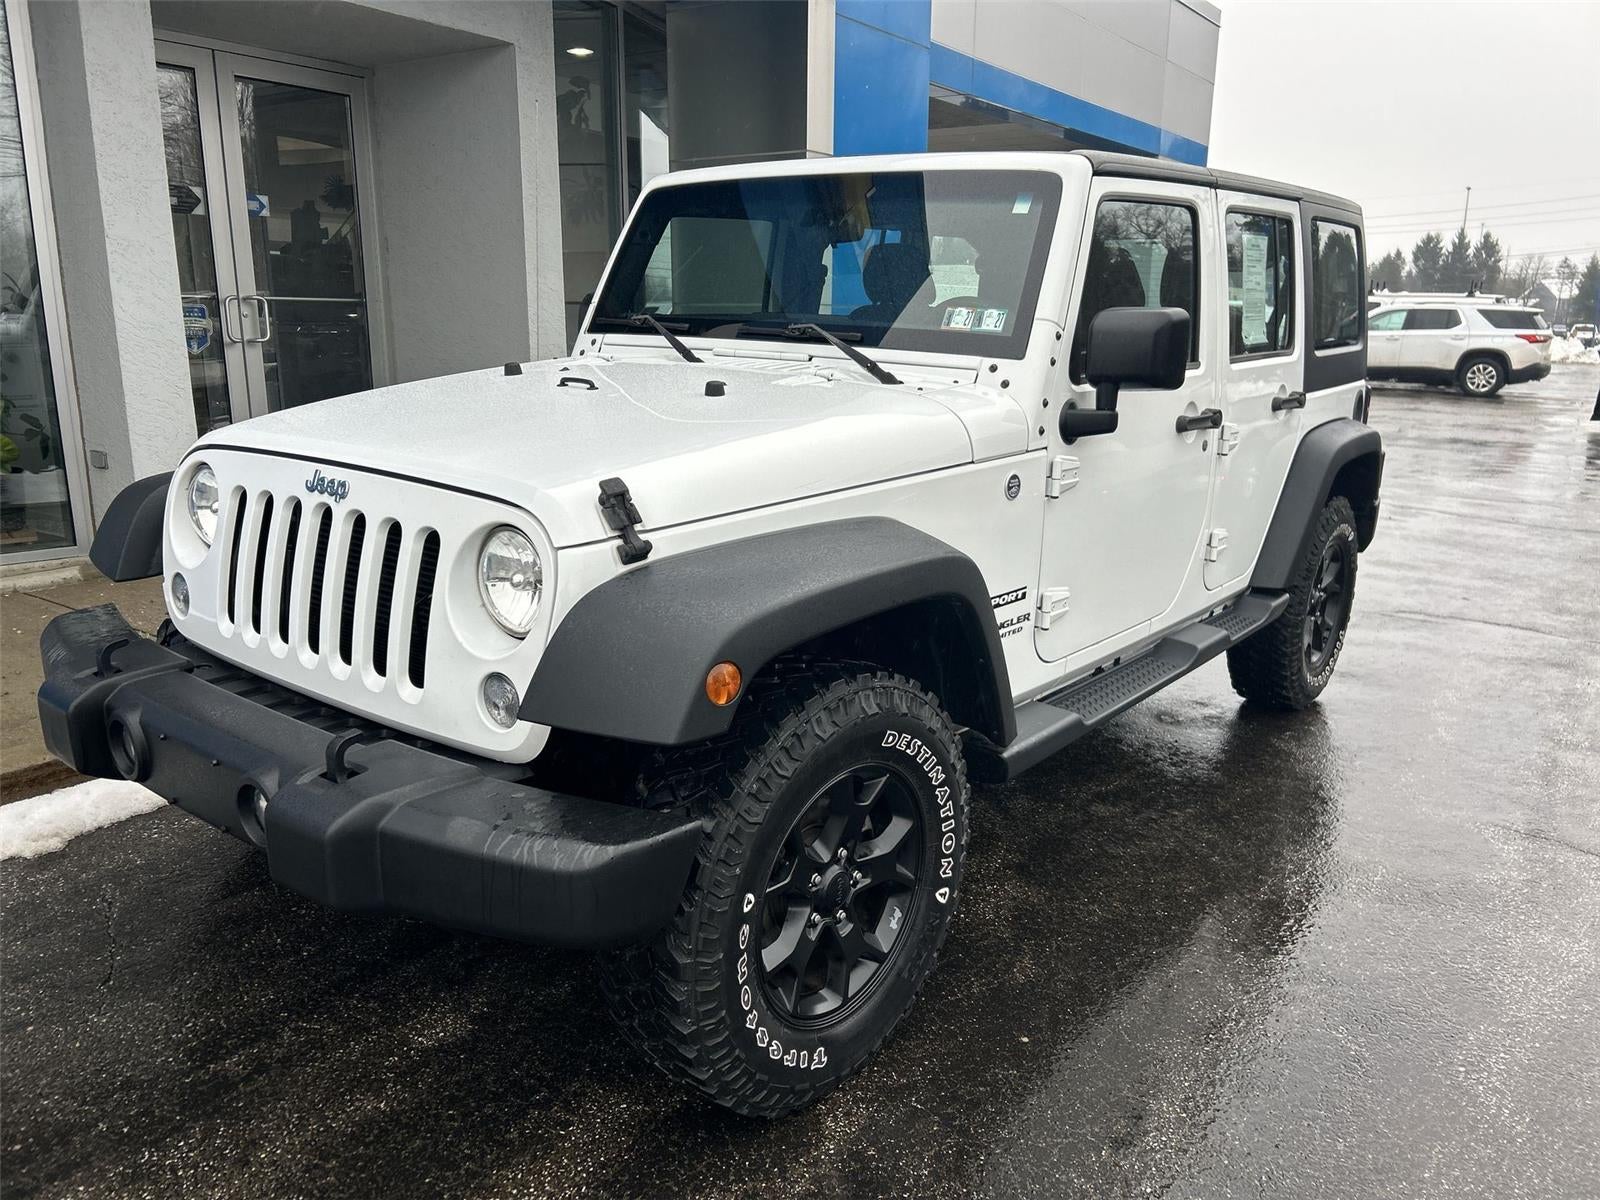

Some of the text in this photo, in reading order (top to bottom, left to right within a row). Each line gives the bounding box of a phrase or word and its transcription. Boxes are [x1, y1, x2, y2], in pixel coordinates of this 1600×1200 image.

[305, 469, 350, 503] Jeep
[991, 590, 1026, 606] PORT
[882, 730, 956, 878] DESTINATION
